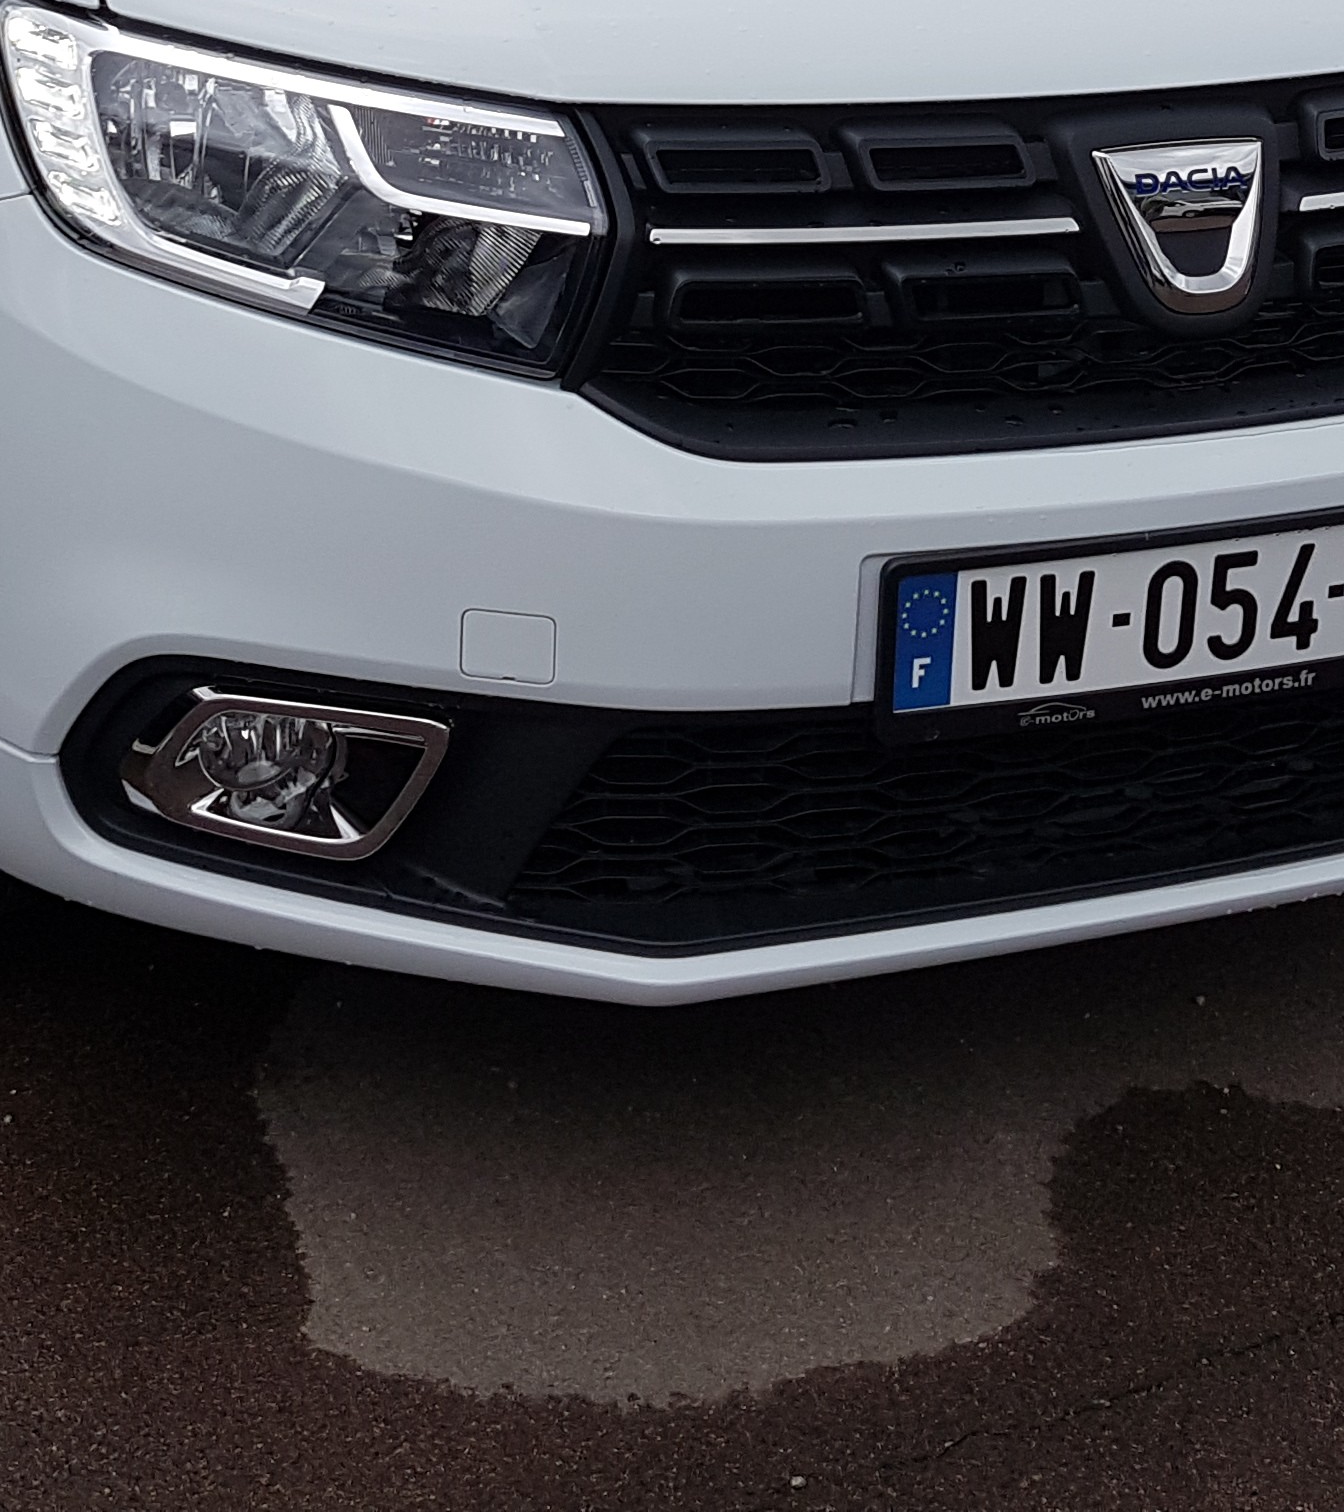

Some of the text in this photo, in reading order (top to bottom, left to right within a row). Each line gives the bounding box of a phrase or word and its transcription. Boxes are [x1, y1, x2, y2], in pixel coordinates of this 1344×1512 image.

[1134, 165, 1248, 196] DACIA
[911, 656, 932, 689] F
[1141, 669, 1317, 710] www.e-motors.fr
